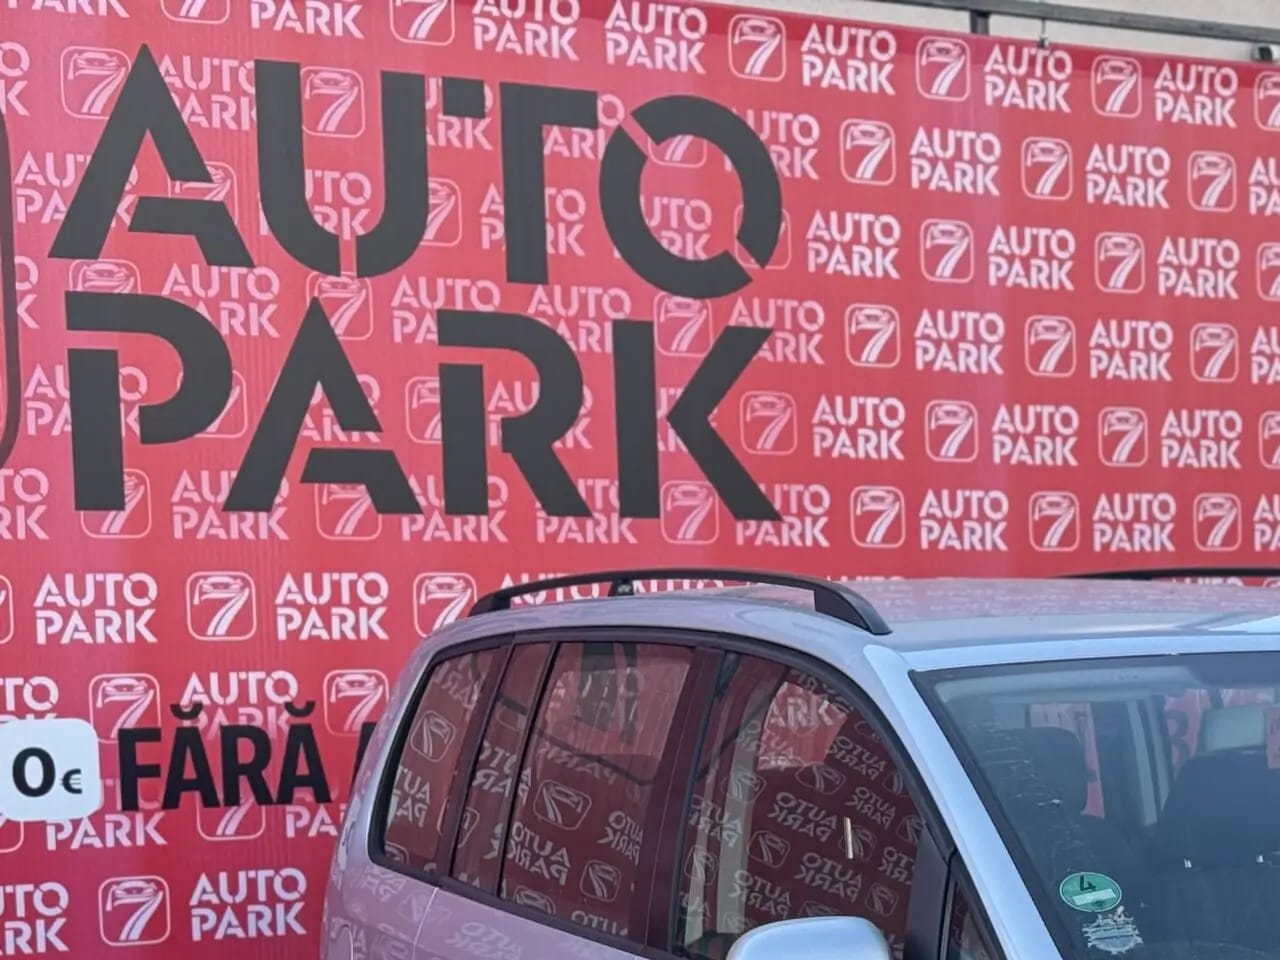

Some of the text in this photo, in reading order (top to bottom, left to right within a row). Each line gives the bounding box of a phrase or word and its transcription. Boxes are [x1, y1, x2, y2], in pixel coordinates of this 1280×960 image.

[252, 1, 364, 39] PARK
[605, 1, 708, 39] AUTO
[473, 18, 580, 60] PARK
[606, 37, 706, 74] PARK
[801, 22, 895, 58] AUTO
[802, 57, 895, 93] PARK
[984, 45, 1071, 77] AUTO
[984, 74, 1071, 111] PARK
[1154, 65, 1237, 95] AUTO
[1155, 93, 1236, 127] PARK
[910, 126, 1000, 159] AUTO
[48, 42, 782, 300] AUTO
[911, 158, 999, 194] PARK
[1086, 144, 1170, 176] AUTO
[1086, 173, 1168, 207] PARK
[806, 211, 900, 244] AUTO
[988, 225, 1075, 258] AUTO
[807, 242, 900, 277] PARK
[1157, 237, 1239, 268] AUTO
[162, 262, 279, 300] AUTO
[988, 255, 1073, 288] PARK
[1158, 266, 1238, 298] PARK
[392, 276, 500, 312] AUTO
[528, 284, 631, 318] AUTO
[729, 299, 825, 332] AUTO
[913, 308, 1004, 341] AUTO
[1089, 320, 1172, 351] AUTO
[916, 340, 1003, 373] PARK
[1090, 348, 1171, 379] PARK
[65, 291, 782, 521] PARK
[812, 395, 905, 427] AUTO
[991, 403, 1079, 436] AUTO
[1161, 410, 1242, 440] AUTO
[814, 427, 904, 459] PARK
[992, 435, 1078, 465] PARK
[1161, 438, 1241, 468] PARK
[919, 488, 1009, 520] AUTO
[1093, 492, 1176, 521] AUTO
[173, 505, 289, 540] PARK
[402, 516, 508, 544] PARK
[536, 516, 637, 544] PARK
[736, 516, 829, 546] PARK
[920, 519, 1007, 550] PARK
[1093, 521, 1175, 550] PARK
[33, 572, 158, 608] AUTO
[275, 572, 389, 607] AUTO
[35, 608, 158, 644] PARK
[276, 607, 388, 641] PARK
[180, 670, 298, 706] AUTO
[118, 701, 331, 811] FĂRĂ
[46, 813, 168, 851] PARK
[190, 867, 307, 906] AUTO
[191, 902, 306, 941] PARK
